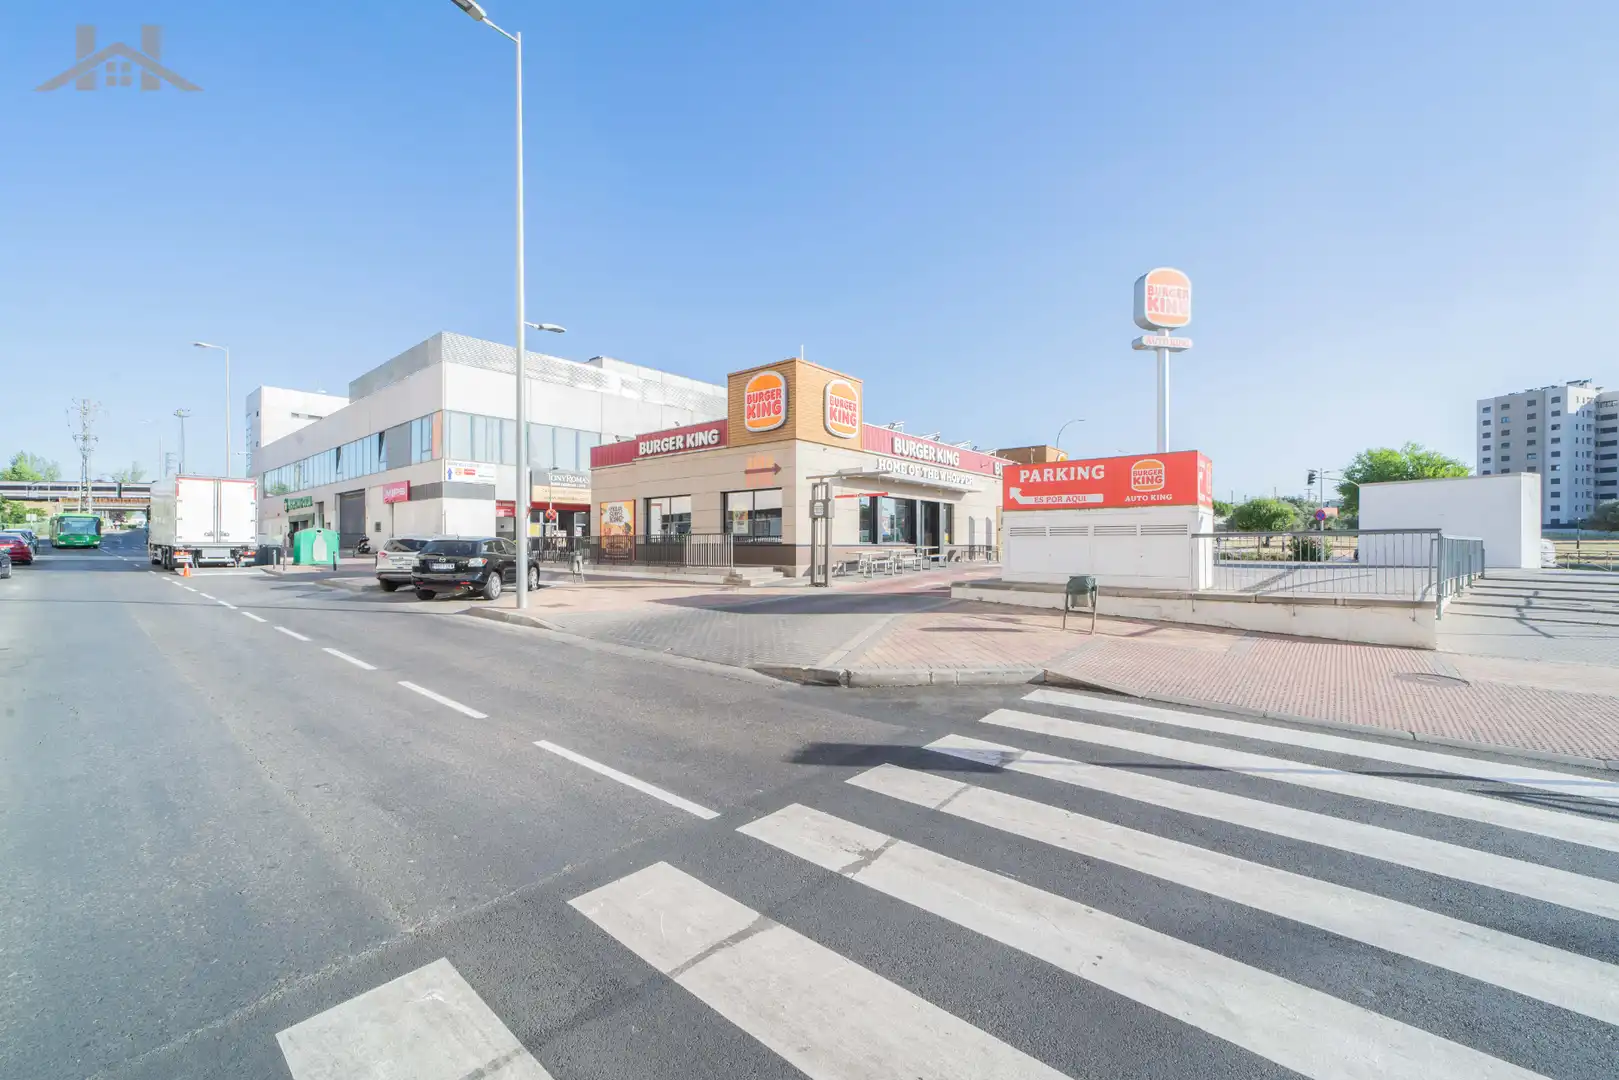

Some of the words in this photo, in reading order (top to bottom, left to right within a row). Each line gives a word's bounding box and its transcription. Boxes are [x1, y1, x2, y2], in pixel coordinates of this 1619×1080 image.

[747, 388, 782, 404] BURGER
[830, 395, 857, 412] BURGER
[747, 400, 782, 419] KING
[829, 405, 857, 426] KING
[639, 435, 684, 456] BURGER
[686, 429, 719, 448] KING
[893, 436, 937, 461] BURGER
[937, 447, 960, 466] KING
[878, 458, 907, 475] HOME
[922, 467, 939, 480] THE
[940, 470, 973, 485] WHOPPER
[1020, 465, 1104, 483] PARKING
[1132, 469, 1163, 477] BURGER
[1132, 475, 1163, 486] KING
[1065, 495, 1087, 503] AQUI
[1125, 494, 1148, 502] AUTO
[1150, 493, 1173, 501] KING
